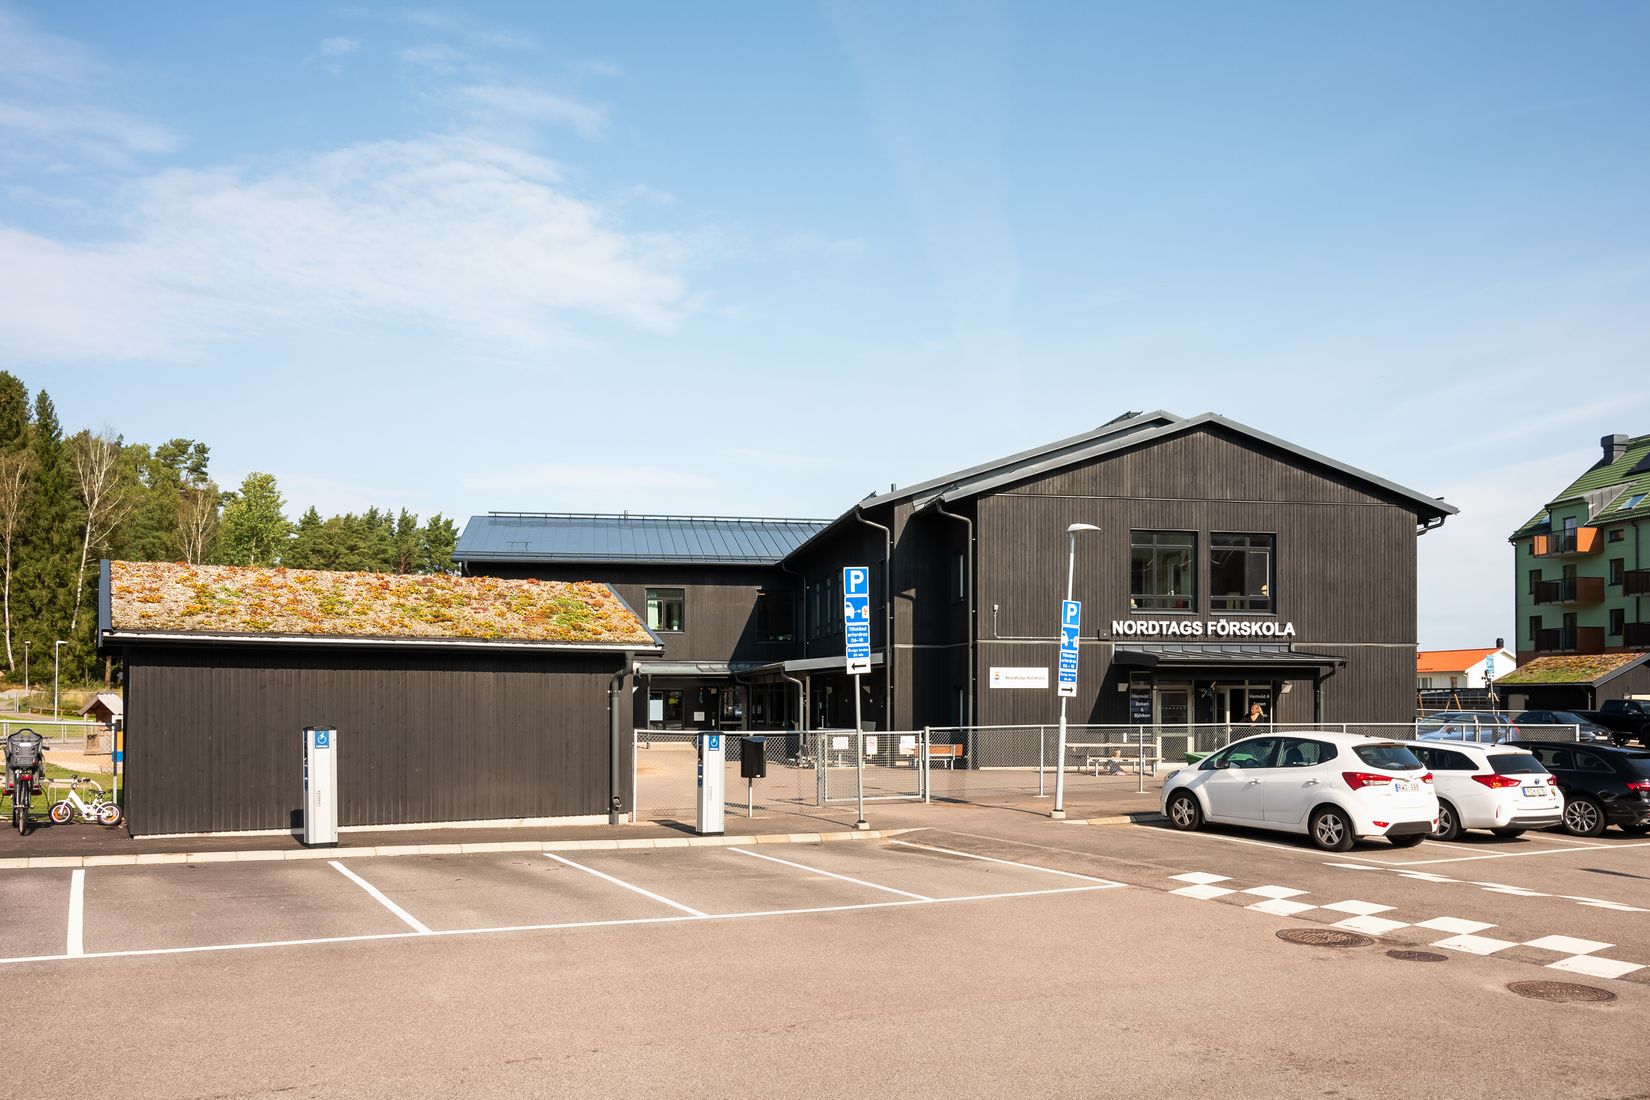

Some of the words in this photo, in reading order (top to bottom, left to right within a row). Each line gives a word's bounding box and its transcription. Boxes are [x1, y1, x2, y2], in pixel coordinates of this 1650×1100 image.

[850, 570, 864, 592] P
[1066, 603, 1077, 623] P
[1112, 620, 1203, 635] NORDTAGS
[1207, 619, 1296, 636] FÖRSKOLA
